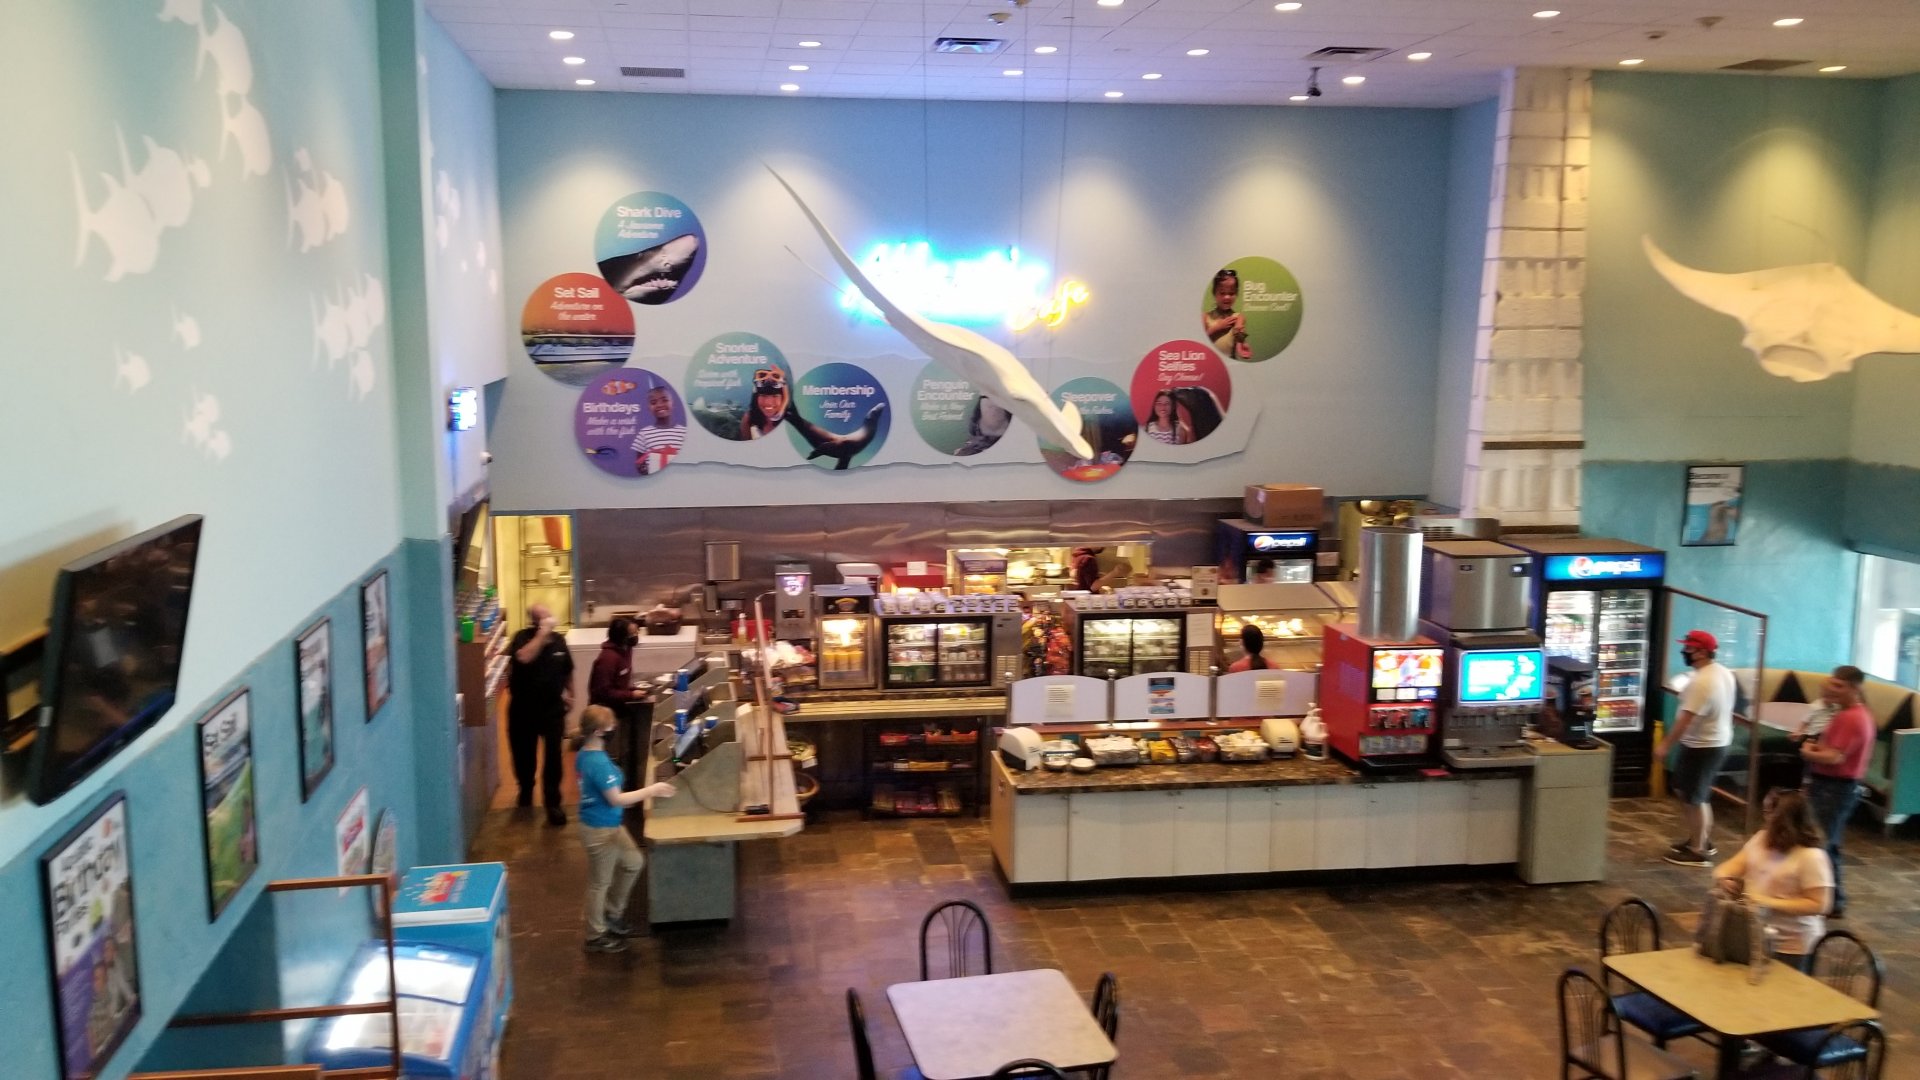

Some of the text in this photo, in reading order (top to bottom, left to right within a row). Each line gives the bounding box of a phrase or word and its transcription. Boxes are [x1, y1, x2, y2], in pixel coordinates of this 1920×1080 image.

[617, 206, 682, 218] Shark Dive
[1243, 280, 1266, 293] Bug
[553, 287, 600, 299] Set Sail
[1243, 291, 1298, 302] Encounter
[715, 342, 759, 354] Snorkel
[708, 354, 768, 365] Adventure
[1159, 350, 1206, 361] Sea Lion
[1158, 361, 1197, 372] Selfies
[802, 384, 876, 398] Membership
[922, 379, 970, 392] Penguin
[917, 390, 974, 401] Encounter
[1061, 391, 1118, 402] Sleepover
[583, 402, 641, 414] Birthdays
[819, 400, 838, 409] Join
[824, 409, 852, 422] Family
[1591, 558, 1642, 576] pepsi
